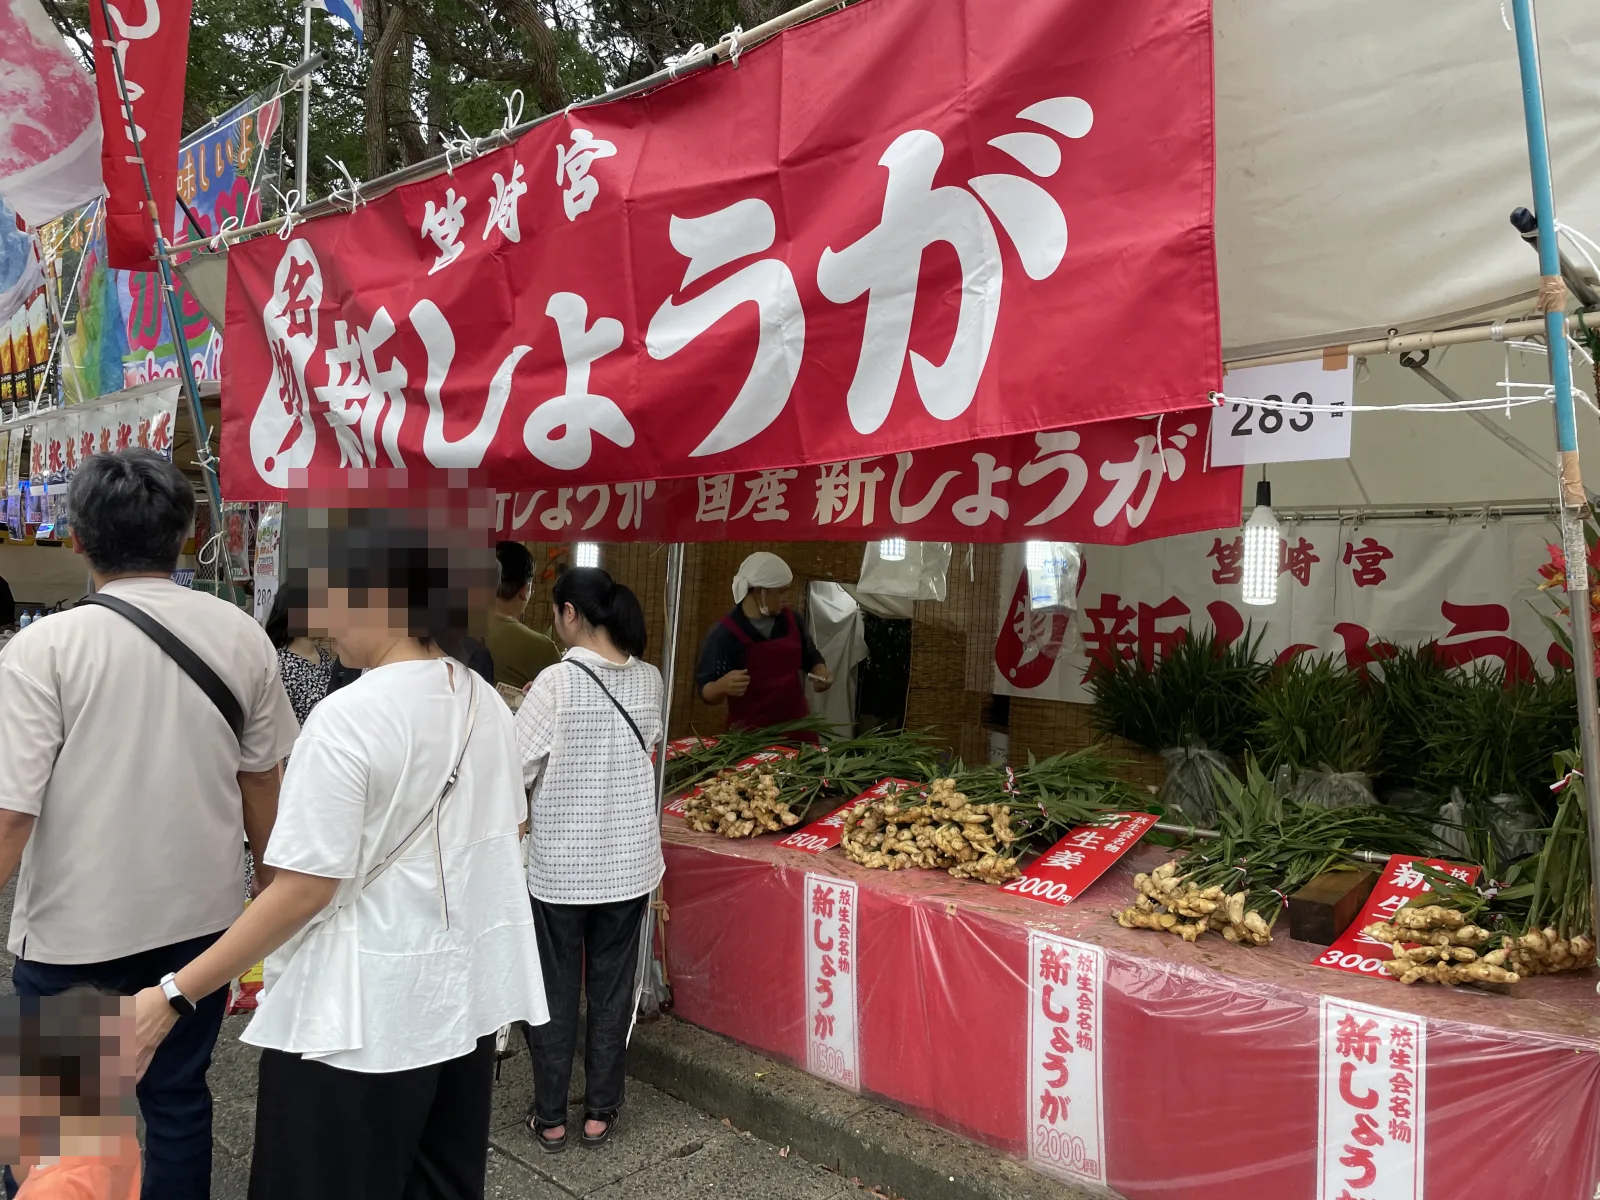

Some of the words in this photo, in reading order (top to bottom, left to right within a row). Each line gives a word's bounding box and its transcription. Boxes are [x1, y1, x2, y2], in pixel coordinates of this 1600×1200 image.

[314, 96, 1093, 470] 新しょうが
[1231, 392, 1314, 436] 283
[695, 468, 798, 523] 国産
[812, 423, 1197, 528] 新しょうが
[256, 588, 272, 606] 282
[838, 889, 852, 974] 放生会名物
[1004, 876, 1073, 903] 2000円
[812, 884, 837, 1041] 新しょうが
[1076, 952, 1094, 1052] 放生会名物
[812, 1041, 854, 1086] 1500円
[1039, 944, 1074, 1125] 新しょうが
[1388, 1024, 1414, 1144] 放生会名物
[1036, 1124, 1097, 1175] 2000円
[1335, 1013, 1385, 1200] 新しょう
